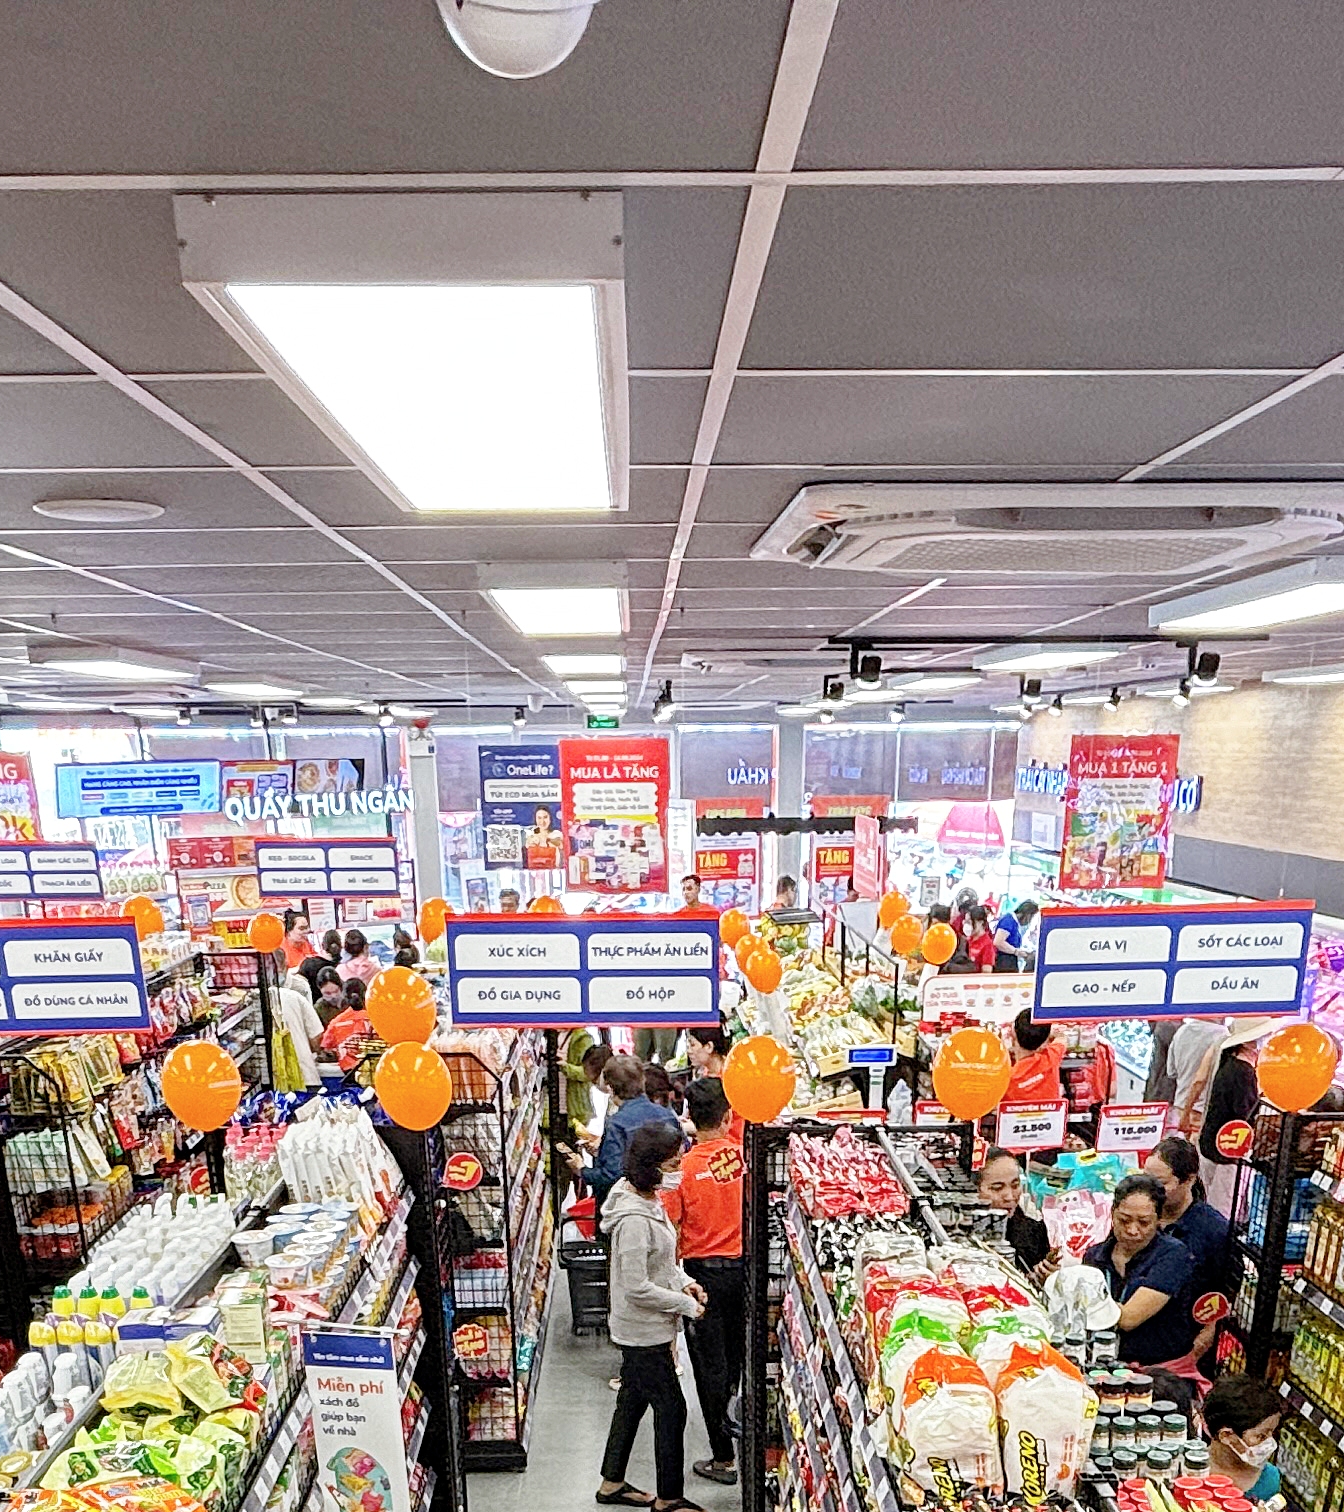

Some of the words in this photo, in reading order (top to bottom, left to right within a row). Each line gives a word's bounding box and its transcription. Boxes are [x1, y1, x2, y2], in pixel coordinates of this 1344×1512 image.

[570, 767, 601, 779] MUA
[603, 763, 620, 778] LÀ
[623, 763, 659, 781] TẶNG
[1078, 762, 1106, 774] MUA
[1111, 762, 1118, 774] 1
[1123, 759, 1157, 776] TẶNG
[1161, 761, 1168, 774] 1
[224, 786, 294, 826] QUẦY
[296, 792, 347, 818] THU
[1089, 939, 1112, 952] GIA
[1114, 939, 1127, 954] VỊ
[1197, 933, 1224, 949] SỐT
[1226, 933, 1252, 948] CÁC
[1254, 935, 1284, 950] LOẠI
[488, 943, 515, 958] XÚC
[517, 943, 547, 958] XÍCH
[591, 946, 624, 961] THỰC
[626, 942, 661, 957] PHẨM
[664, 943, 681, 957] ĂN
[1072, 983, 1100, 998] GẠO
[1112, 978, 1136, 994] NẾP
[1240, 976, 1260, 990] ĂN
[78, 992, 94, 1006] CÁ
[501, 988, 522, 1001] GIA
[525, 988, 562, 1004] DỤNG
[649, 986, 676, 1003] HỘP
[318, 1376, 354, 1394] Miễn
[360, 1380, 385, 1396] phí
[320, 1397, 343, 1408] xách
[346, 1412, 367, 1423] bạn
[338, 1427, 357, 1437] nhà
